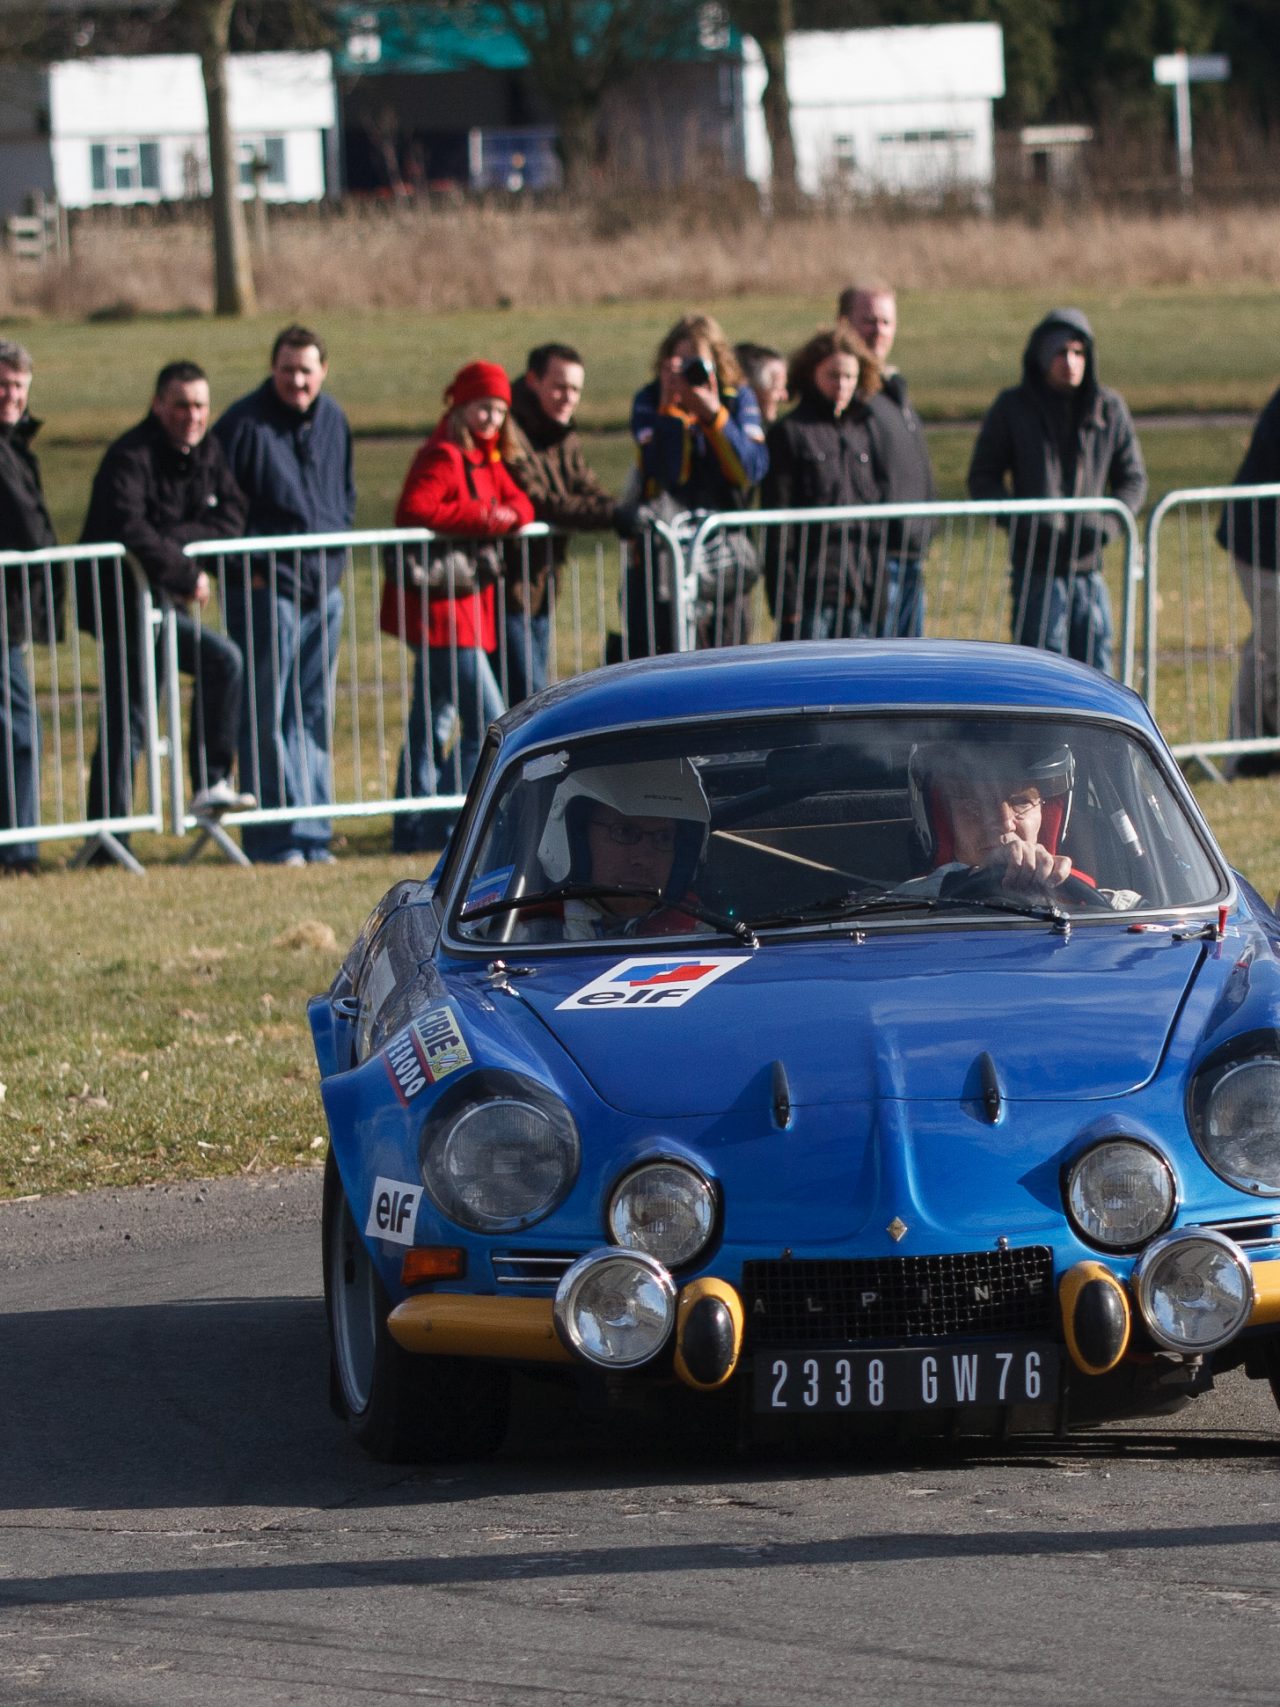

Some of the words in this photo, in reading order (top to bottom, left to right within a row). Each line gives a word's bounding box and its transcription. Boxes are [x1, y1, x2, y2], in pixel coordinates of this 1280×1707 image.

[576, 988, 690, 1006] elf
[376, 1191, 415, 1233] elf
[771, 1357, 884, 1408] 2338
